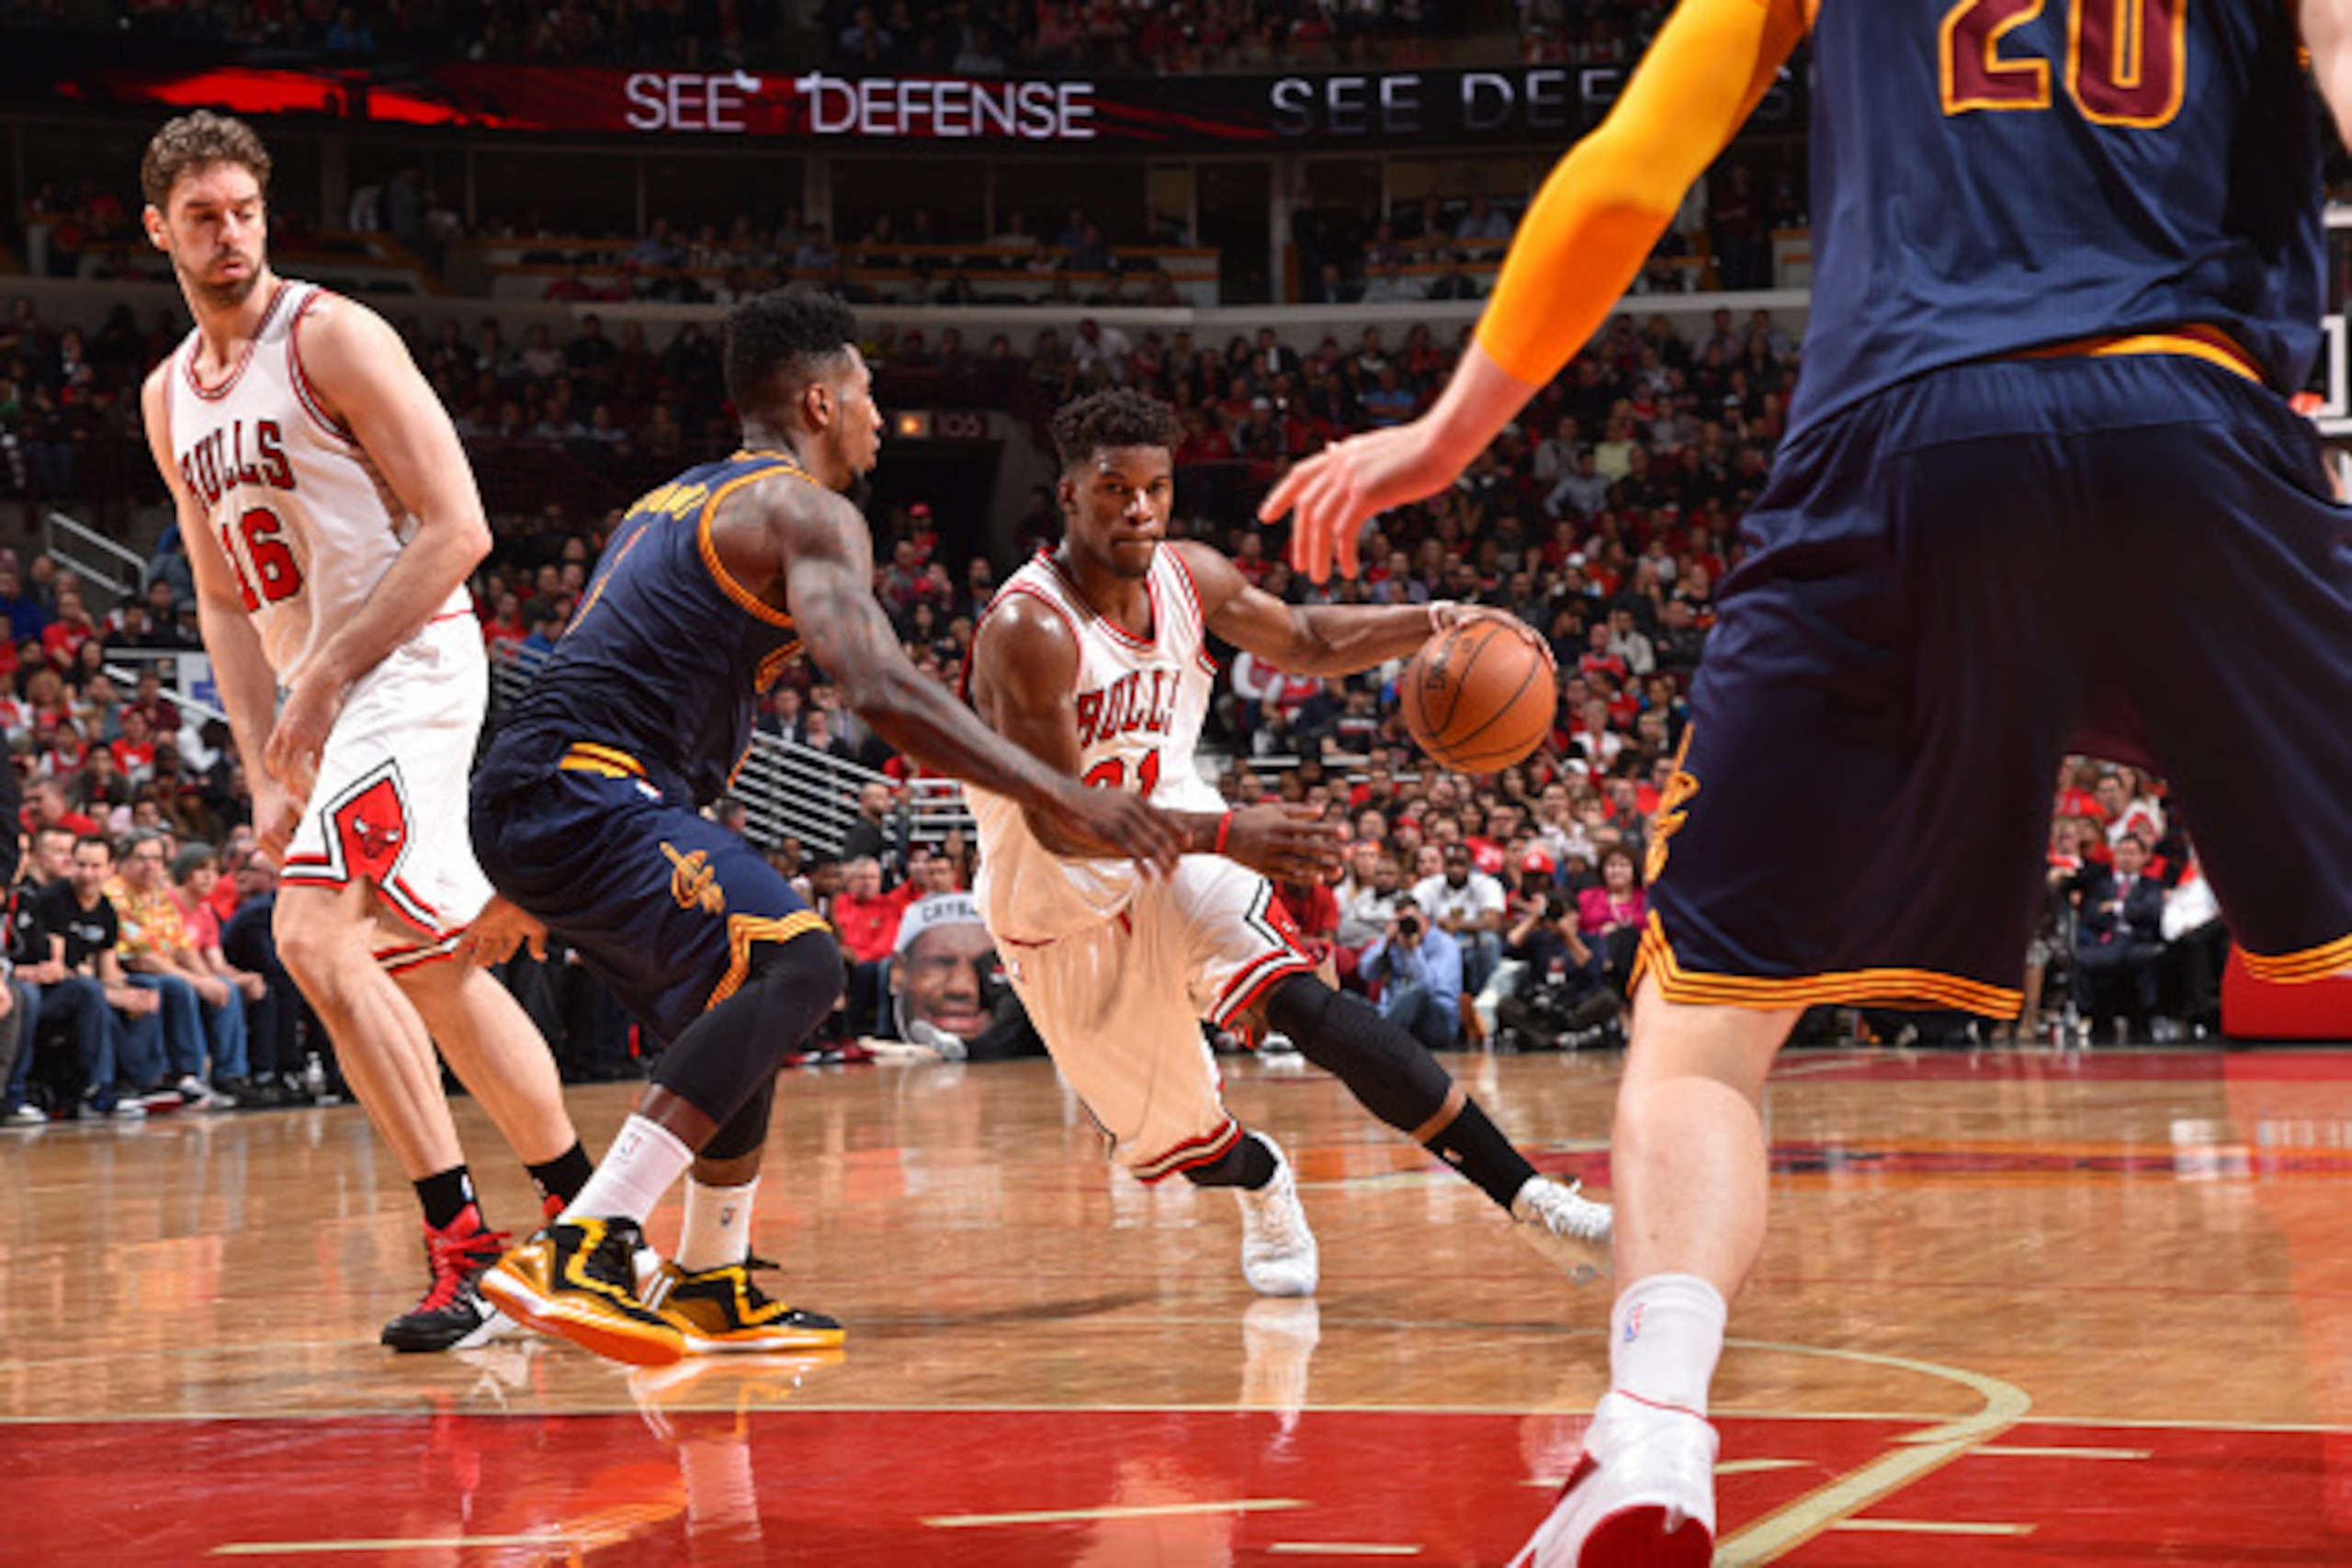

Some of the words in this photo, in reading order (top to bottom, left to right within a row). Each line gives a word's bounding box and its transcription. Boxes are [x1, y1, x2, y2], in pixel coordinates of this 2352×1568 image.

[624, 73, 745, 130] SEE
[810, 76, 1096, 138] DEFENSE
[1271, 75, 1423, 137] SEE
[1939, 0, 2186, 129] 20
[221, 508, 302, 613] 16
